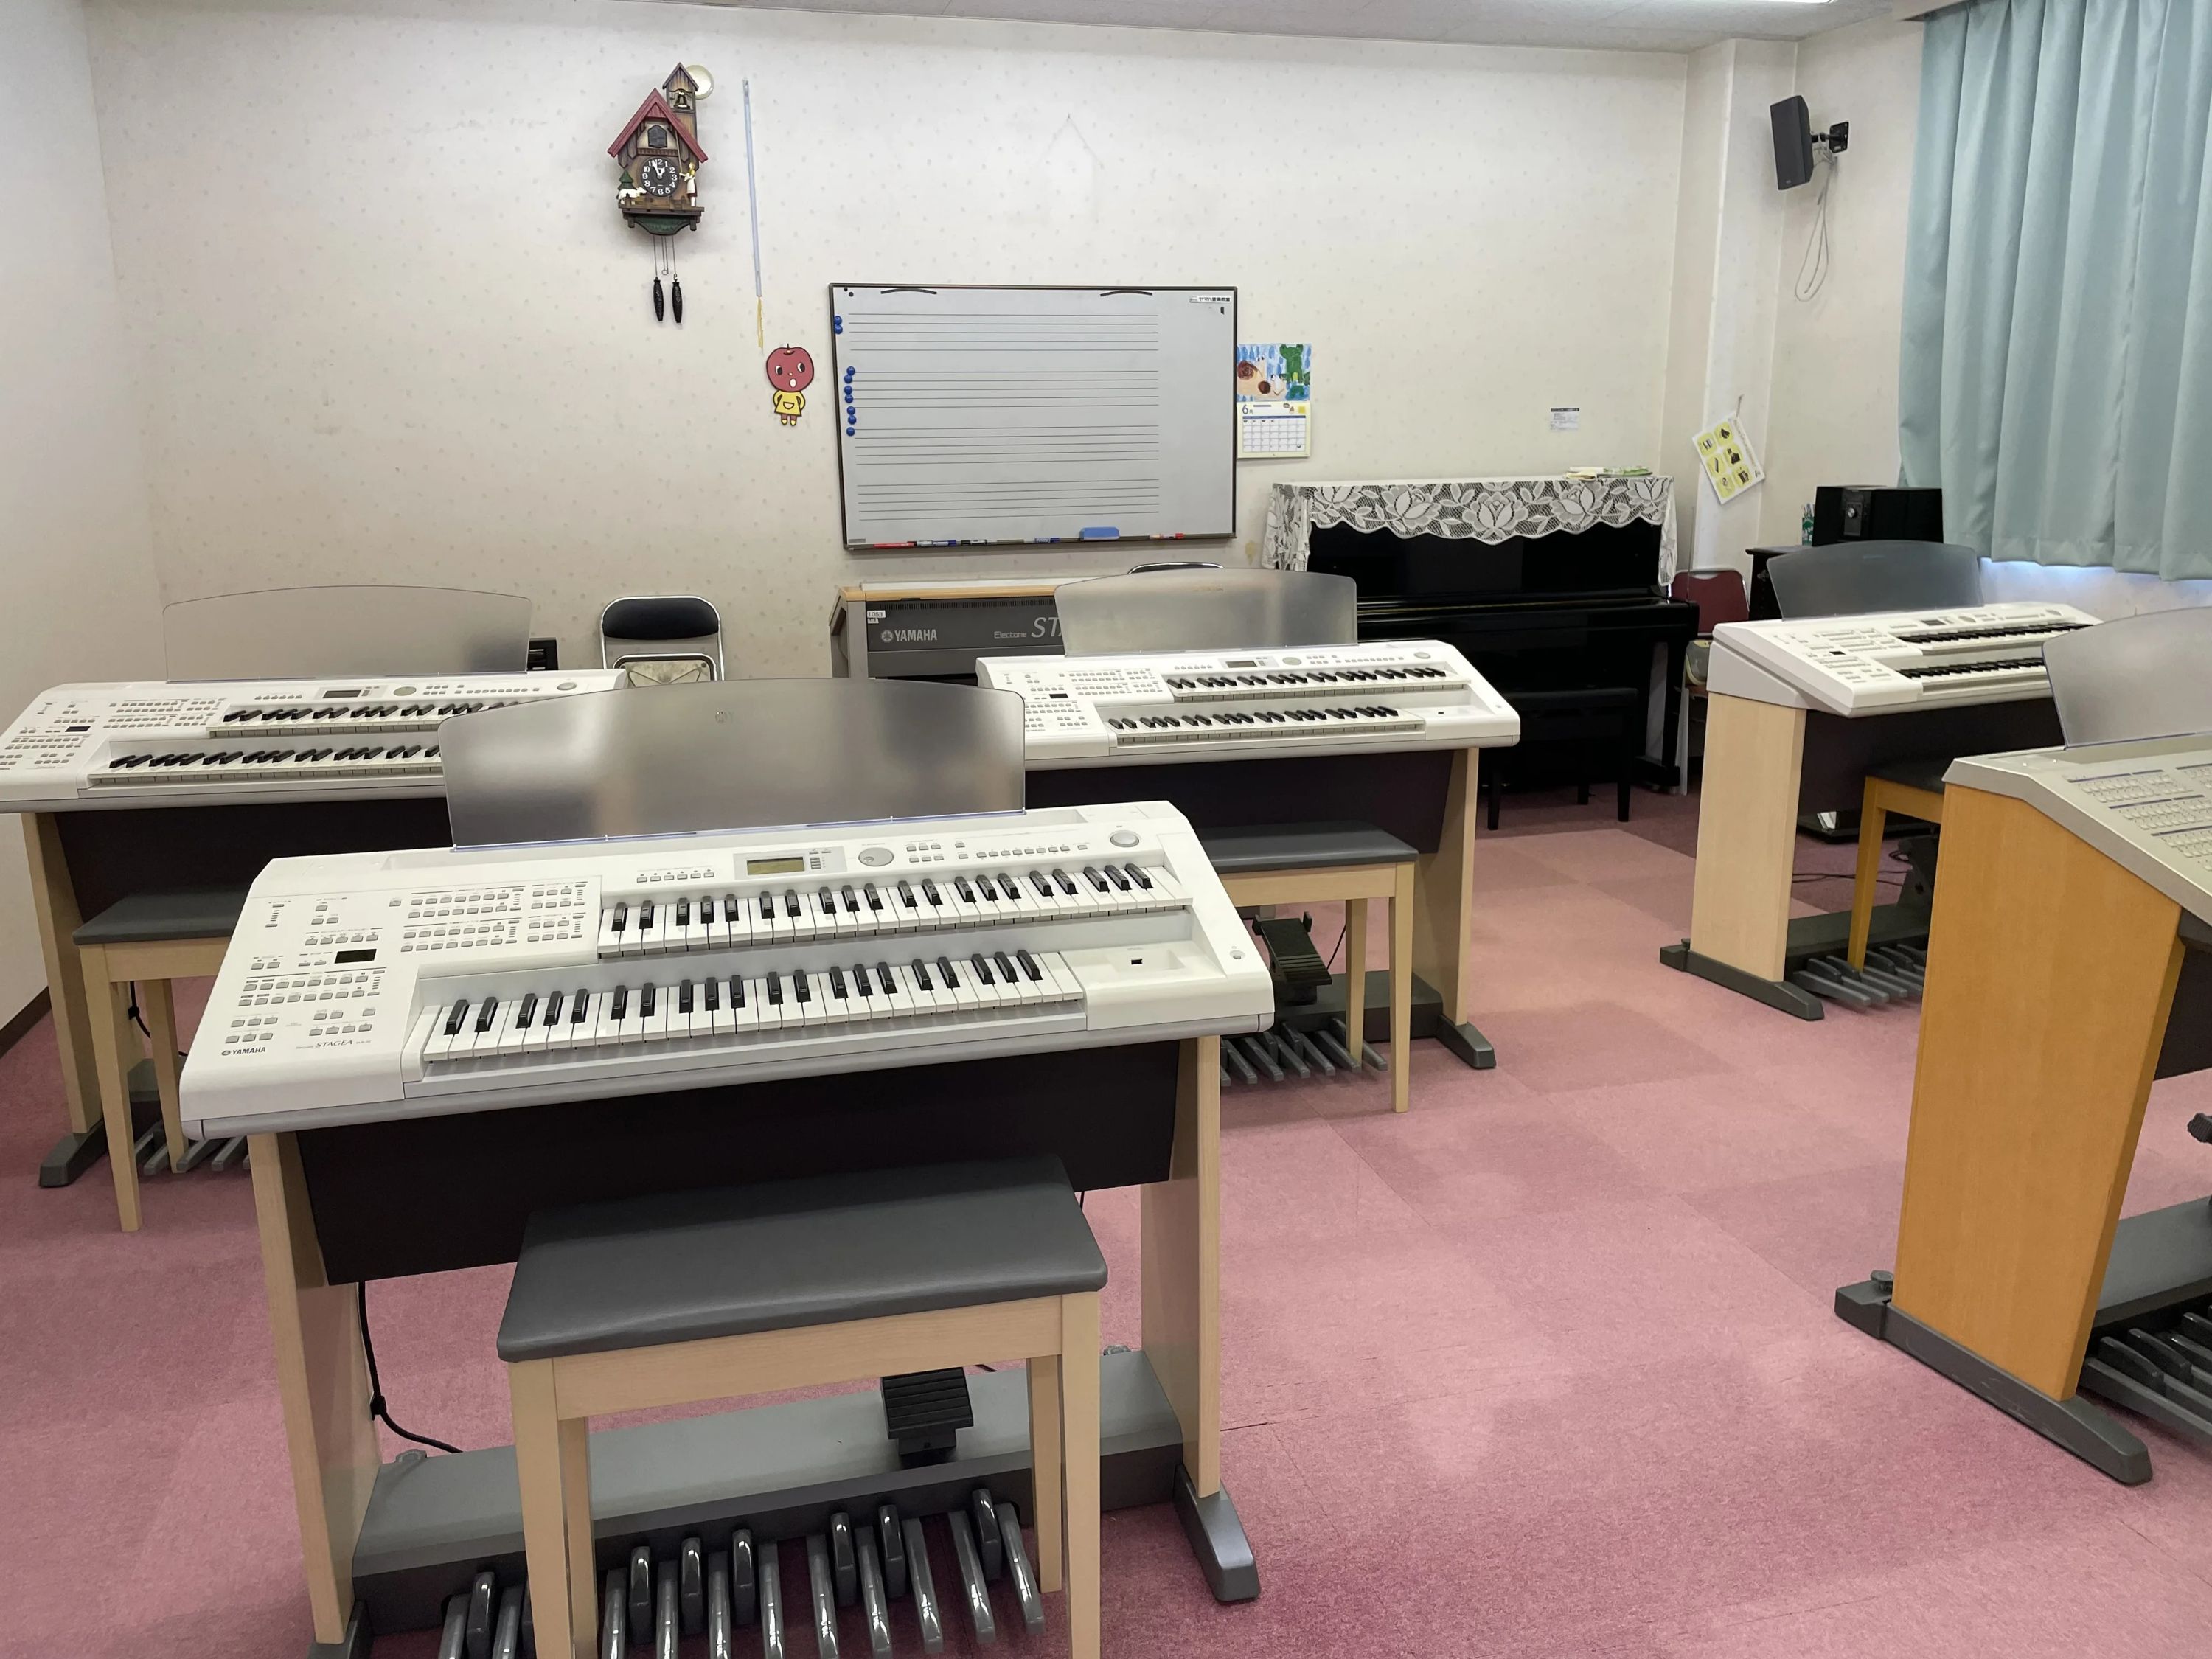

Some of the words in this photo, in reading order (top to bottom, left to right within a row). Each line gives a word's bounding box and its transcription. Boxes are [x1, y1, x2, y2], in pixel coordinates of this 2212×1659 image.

[993, 630, 1027, 639] Electone
[1031, 617, 1062, 638] ST
[894, 629, 938, 642] YAMAHA
[316, 1040, 352, 1048] STAGEA
[232, 1046, 266, 1055] YAMAHA
